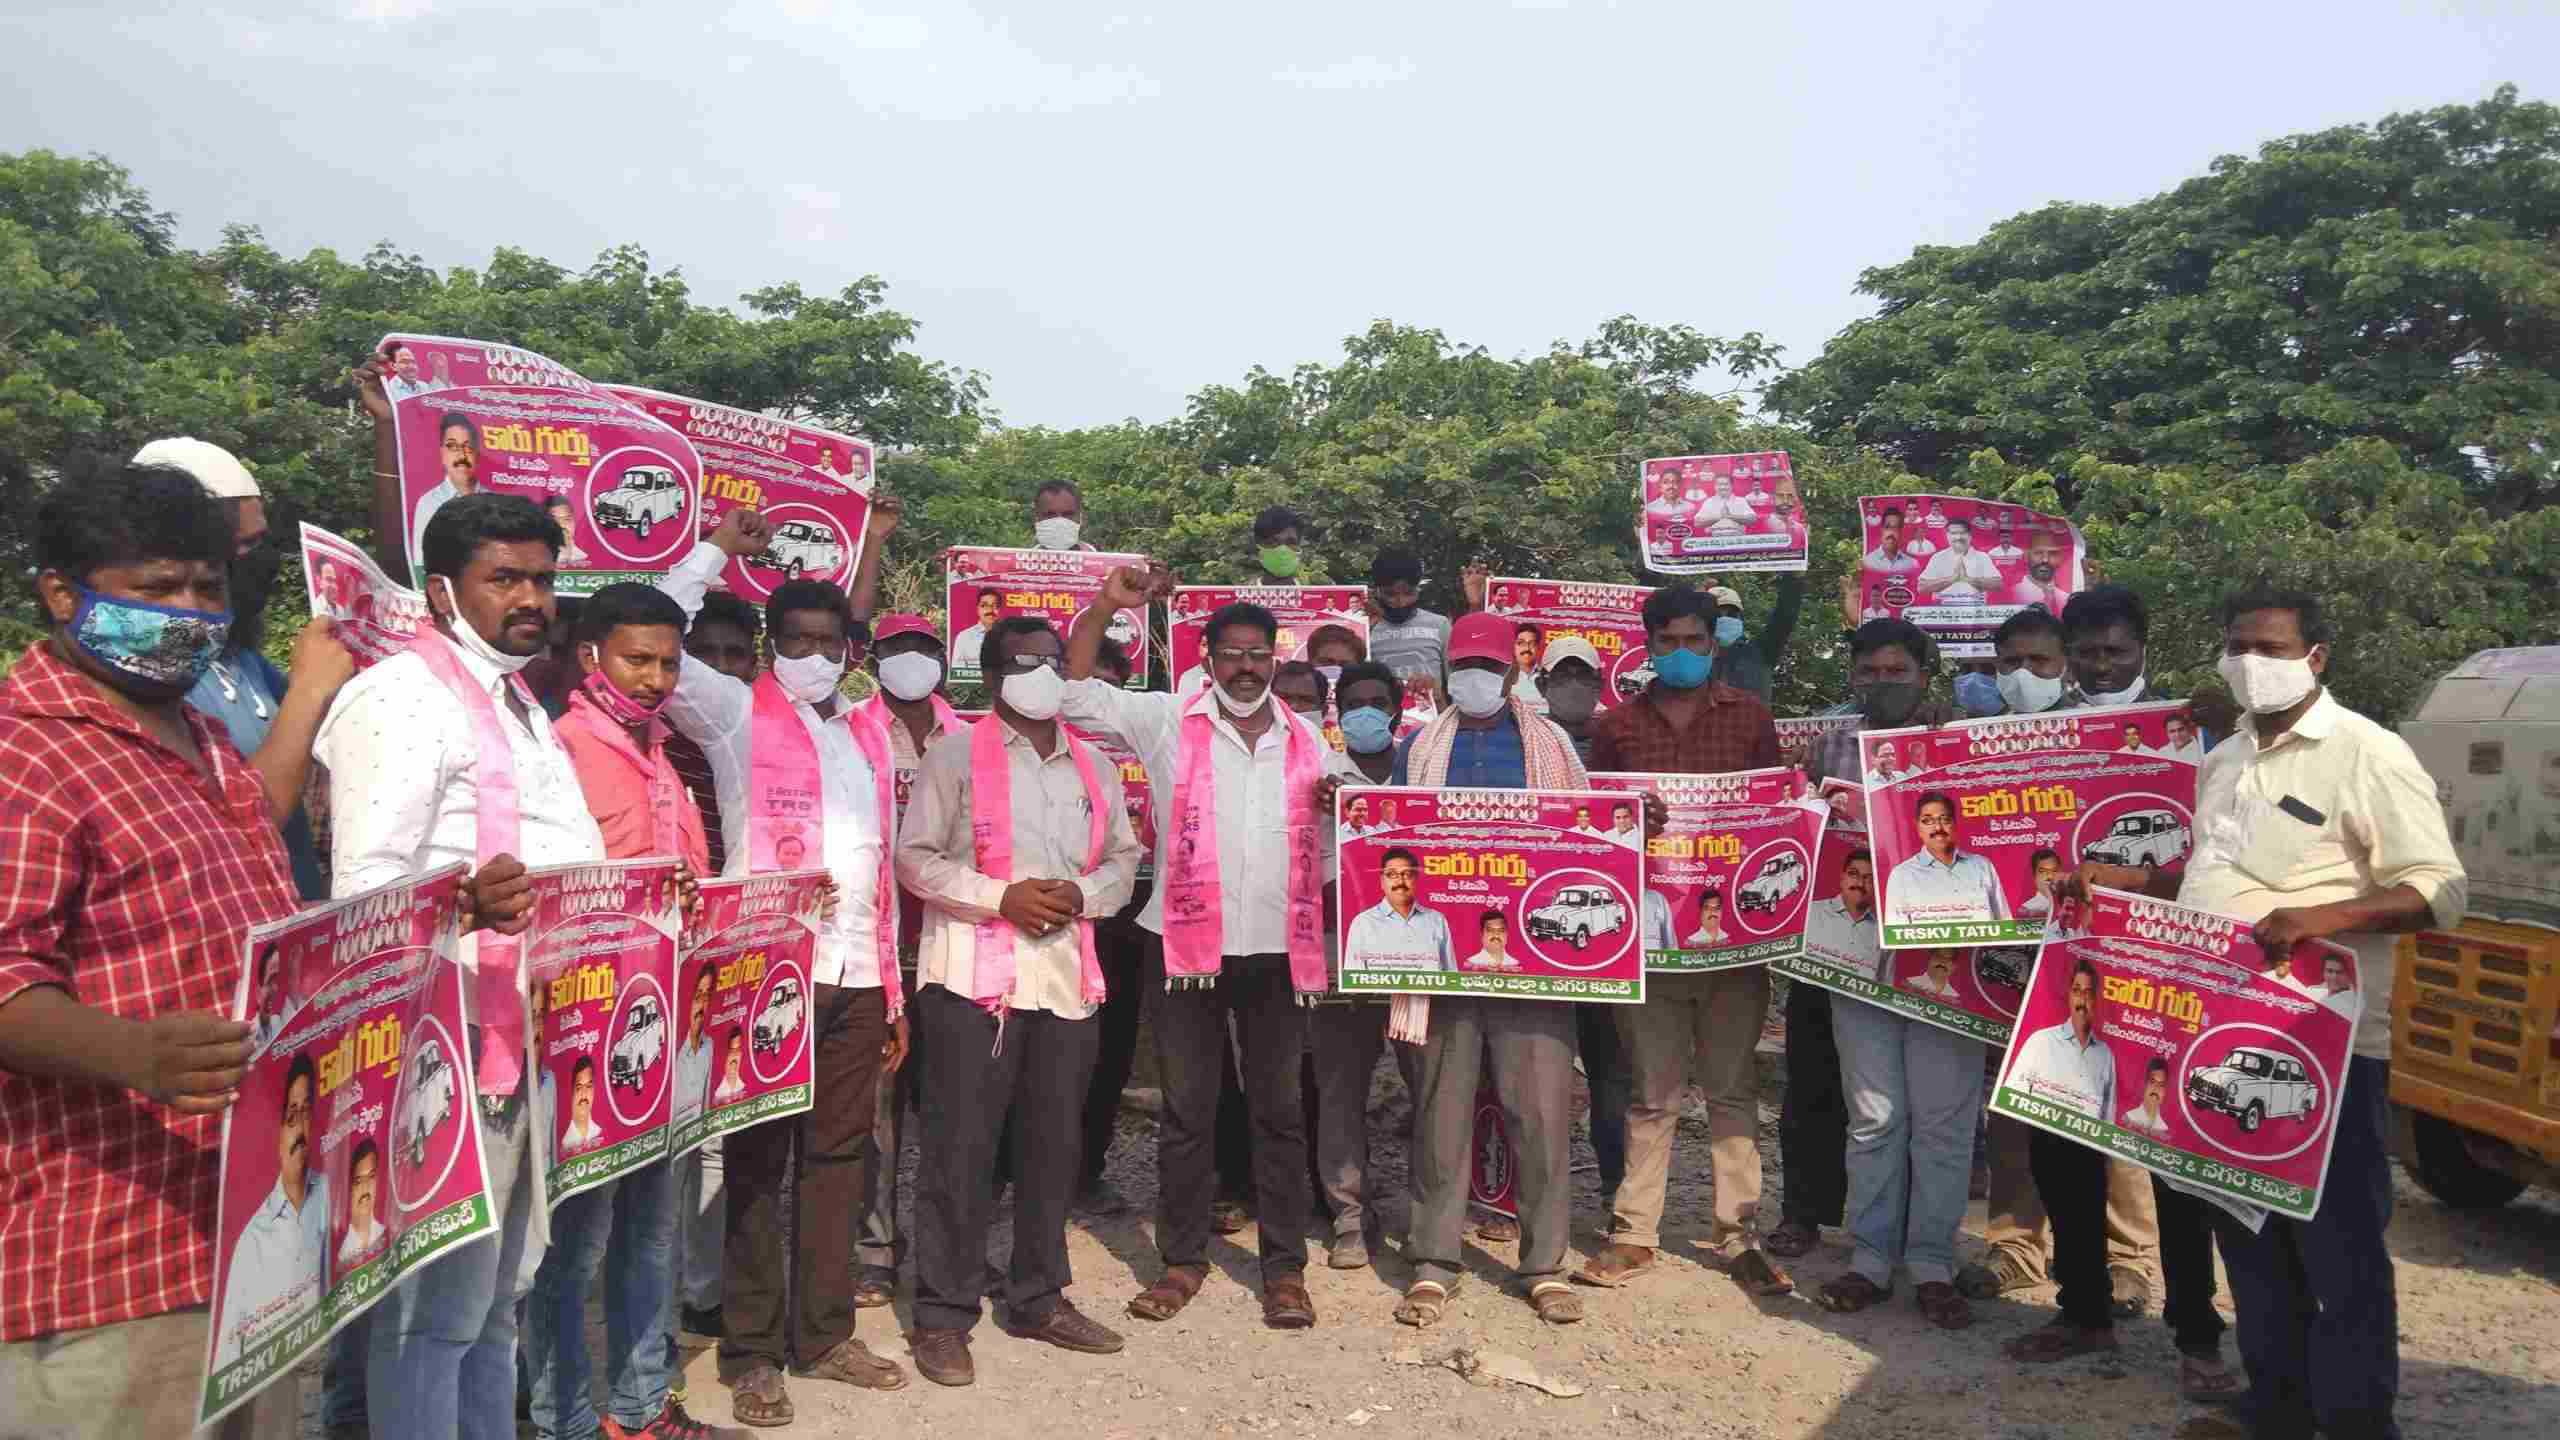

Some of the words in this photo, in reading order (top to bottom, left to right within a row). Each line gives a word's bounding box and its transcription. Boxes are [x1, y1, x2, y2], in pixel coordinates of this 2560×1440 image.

[481, 424, 533, 452] కారు
[535, 426, 591, 466] గుర్తు
[1960, 789, 2018, 817] కారు
[2021, 785, 2077, 820] గుర్తు
[1646, 833, 1693, 858] కారు
[1698, 832, 1740, 864] గుర్తు
[1423, 852, 1475, 876] కారు
[1479, 852, 1527, 887] గుర్తు
[1893, 925, 1950, 942] TRSKV
[1957, 924, 2000, 939] TATU
[1349, 972, 1402, 985] TRSKV
[1405, 974, 1447, 986] TATU
[1781, 958, 1832, 980] TRSKV
[1839, 976, 1880, 996] TATU
[2103, 975, 2155, 1009] కారు
[2157, 986, 2203, 1034] గుర్తు
[2008, 1092, 2063, 1121] TRSKV
[2064, 1114, 2102, 1136] TATU
[2202, 1162, 2247, 1186] నగర
[218, 1342, 280, 1401] TRSKV
[285, 1310, 320, 1354] TATU
